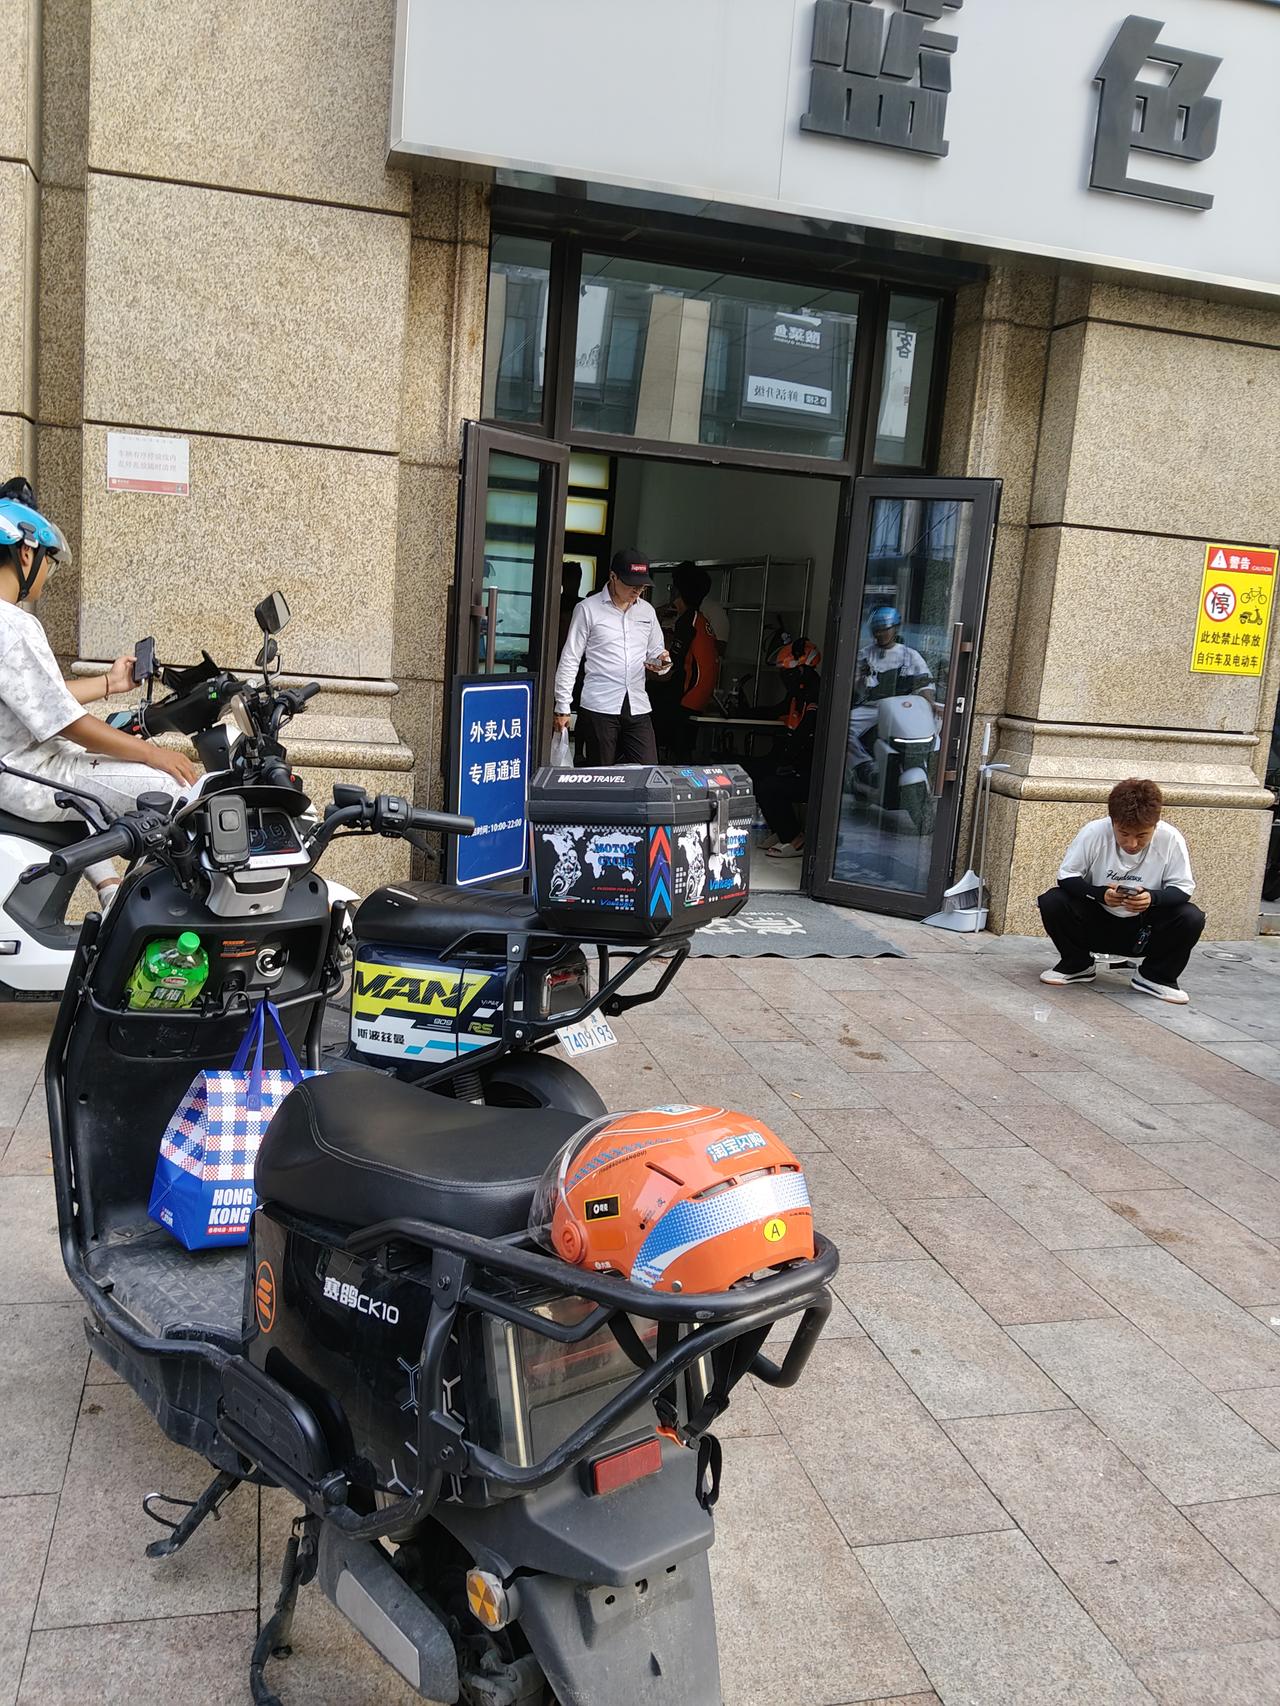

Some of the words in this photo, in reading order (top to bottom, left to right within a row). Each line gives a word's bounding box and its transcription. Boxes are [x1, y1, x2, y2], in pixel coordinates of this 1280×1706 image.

[1229, 555, 1251, 570] 警告
[1200, 630, 1261, 647] 此处禁止停放
[1196, 652, 1259, 668] 自行车及电动车
[469, 718, 522, 743] 外卖人员
[468, 758, 521, 785] 专属通道
[557, 774, 593, 783] MOTO
[592, 775, 626, 783] TRAVEL
[595, 843, 636, 854] MOTOR
[357, 1028, 405, 1045] 斯波兹曼
[467, 1021, 495, 1035] RS
[563, 1025, 614, 1051] 7409193
[708, 1132, 766, 1162] 淘宝闪购
[212, 1188, 253, 1206] HONG
[208, 1207, 251, 1225] KONG
[770, 1223, 781, 1239] A
